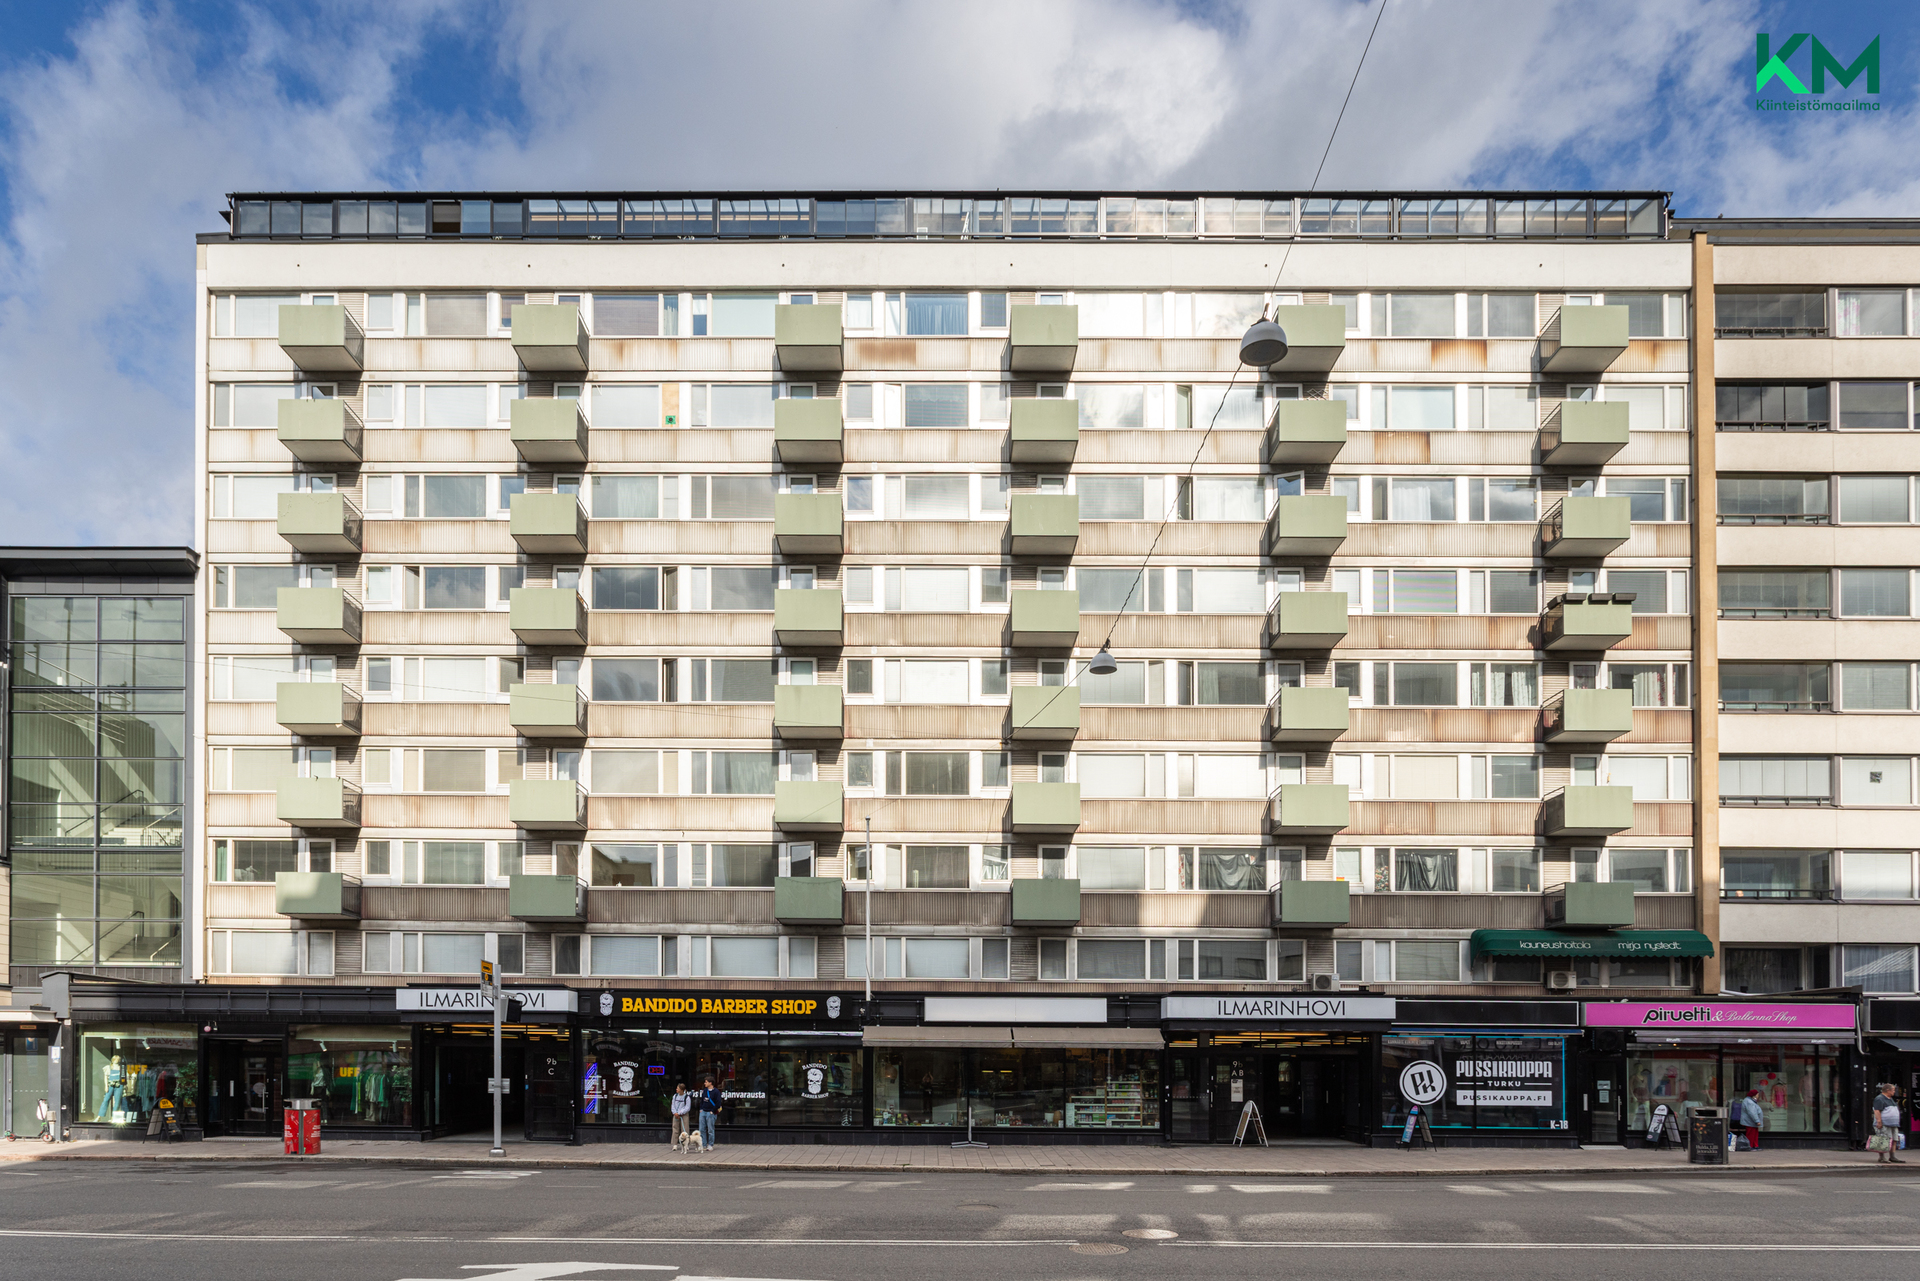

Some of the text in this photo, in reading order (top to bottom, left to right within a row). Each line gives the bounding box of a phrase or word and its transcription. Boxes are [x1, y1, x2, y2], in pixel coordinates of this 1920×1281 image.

[1519, 940, 1591, 949] kauneushoitola
[1618, 941, 1682, 951] mirja nystedt
[420, 992, 545, 1008] ILMARINOVI
[621, 997, 817, 1015] BANDIDO BARBER SHOP
[1218, 1000, 1346, 1016] ILMARINHOVI
[1641, 1006, 1711, 1024] piruetti
[1722, 1010, 1772, 1021] Ballerina
[1771, 1010, 1797, 1025] Shop
[546, 1057, 557, 1065] 9b
[613, 1060, 639, 1068] BANDIDO
[126, 1064, 148, 1075] UFF
[339, 1067, 361, 1077] UFF
[1456, 1060, 1552, 1078] PUSSIKAUPPA
[721, 1090, 766, 1100] ajanvarausta
[1463, 1094, 1547, 1102] PUSSIKAUPPA.FI
[1550, 1119, 1569, 1130] K-18
